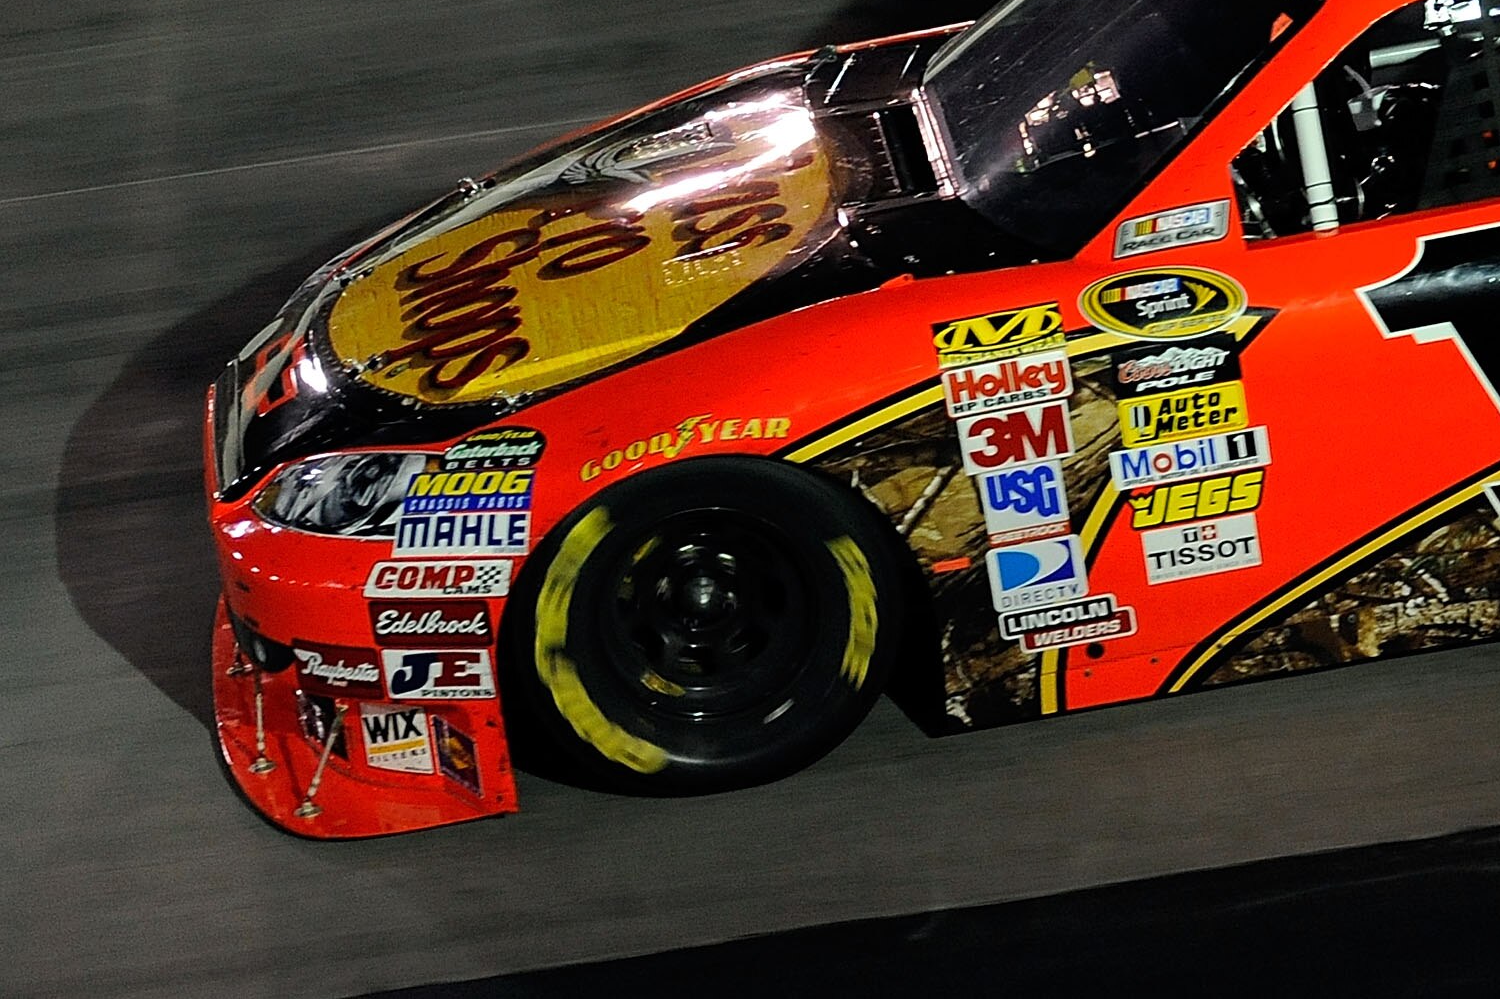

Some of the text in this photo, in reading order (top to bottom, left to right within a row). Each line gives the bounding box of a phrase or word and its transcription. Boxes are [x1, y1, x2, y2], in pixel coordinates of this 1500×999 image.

[1122, 228, 1215, 251] RACE CAR
[376, 225, 545, 401] Shops
[1135, 292, 1192, 318] Sprint
[948, 360, 1067, 404] Holley
[1118, 360, 1172, 383] Coors
[1135, 370, 1216, 392] POLE
[953, 388, 1048, 414] HP CARBS
[1158, 392, 1221, 417] Auto
[968, 405, 1068, 468] 3M
[1154, 407, 1238, 439] Meter
[445, 440, 543, 460] Gatorback
[579, 413, 792, 483] GOODYEAR
[1120, 438, 1217, 480] Mobil
[445, 457, 531, 470] BELTS
[407, 469, 533, 497] MOOG
[985, 465, 1061, 518] USG
[408, 495, 529, 511] CHASSIS PARTS
[1132, 470, 1264, 529] JEGS
[397, 513, 527, 549] MAHLE
[1147, 536, 1256, 570] TISSOT
[375, 565, 476, 590] COMP
[442, 584, 492, 595] CAMS
[1001, 583, 1080, 609] DIRECTV
[375, 609, 489, 635] Edelbrock
[1007, 600, 1109, 633] LINCOLN
[1033, 619, 1122, 647] WELDERS
[391, 651, 481, 695] JE
[420, 688, 496, 698] PISTONS
[361, 707, 424, 744] WIX
